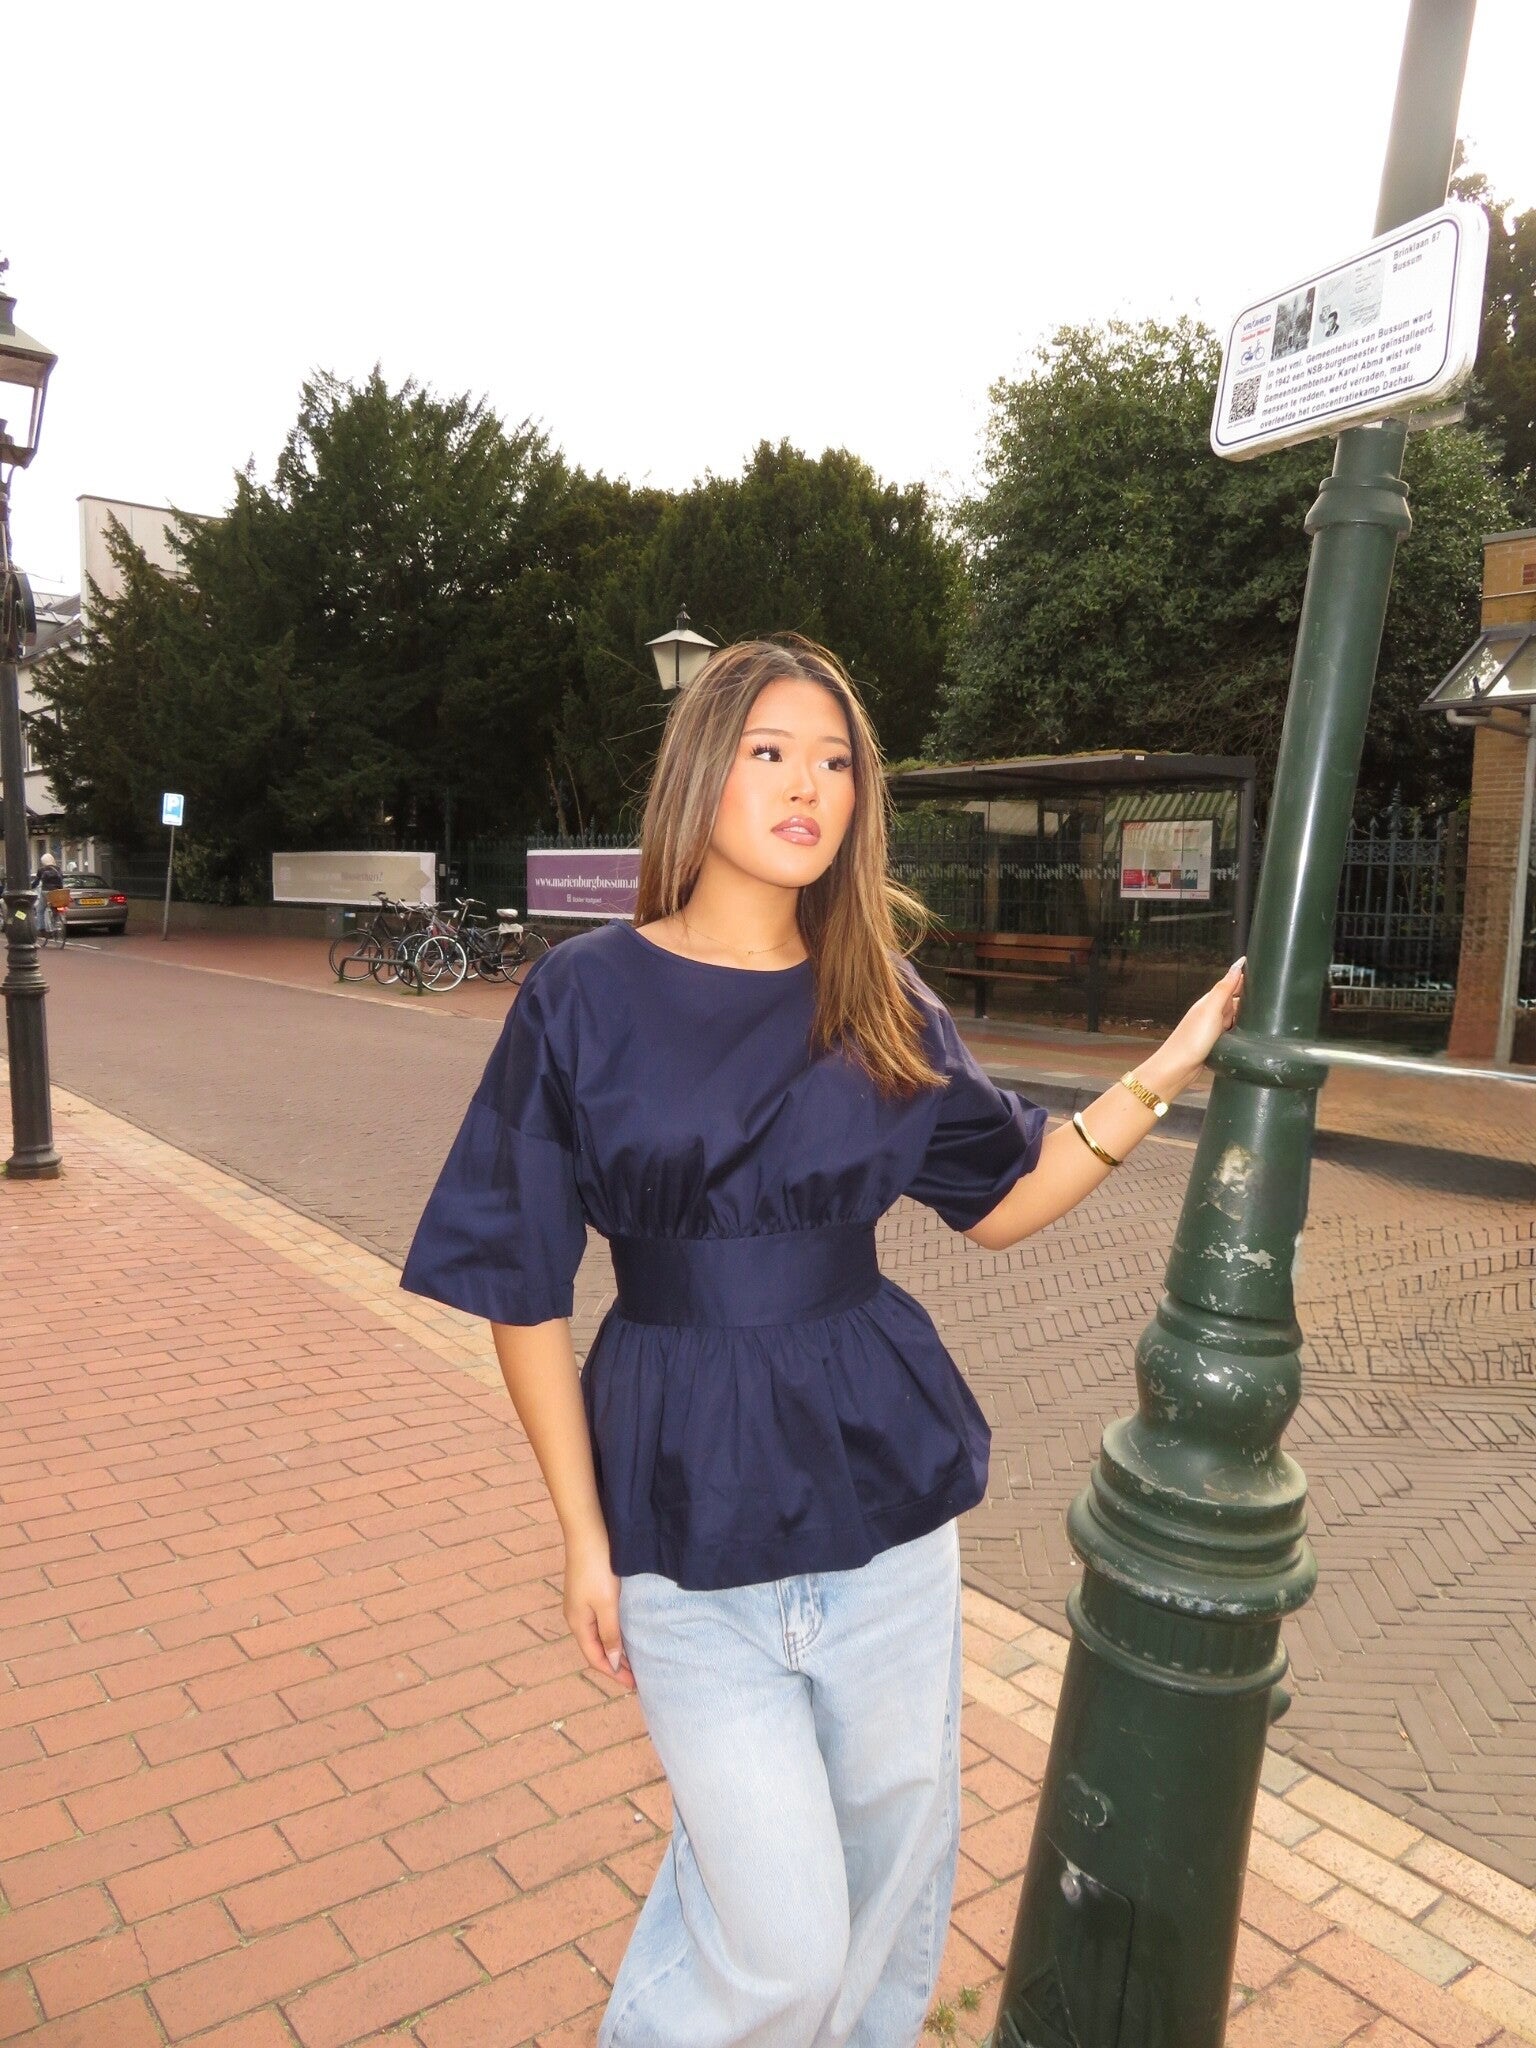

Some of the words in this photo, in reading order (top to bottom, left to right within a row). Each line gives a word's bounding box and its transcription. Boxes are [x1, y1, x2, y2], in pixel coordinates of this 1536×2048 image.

[1392, 253, 1423, 273] Bussum
[1393, 238, 1429, 260] Brinklaan
[1431, 229, 1441, 243] 87
[1276, 364, 1287, 374] het
[1306, 338, 1359, 363] Gemeentehuis
[1361, 333, 1375, 343] van
[1378, 320, 1410, 338] Bussum
[1412, 308, 1432, 324] werd
[1261, 402, 1288, 416] mensen
[1290, 398, 1297, 407] te
[1329, 380, 1348, 393] werd
[1390, 361, 1411, 374] maar
[1264, 373, 1336, 403] Gemeenteambtenaar
[1338, 364, 1359, 378] Karel
[1360, 357, 1384, 371] Abma
[1386, 350, 1402, 362] wist
[1405, 343, 1421, 355] vele
[1265, 382, 1273, 391] in
[1275, 375, 1291, 387] 1942
[1292, 371, 1305, 381] een
[1307, 345, 1378, 376] NSB-burgemeester
[1260, 411, 1296, 429] overleefde
[1298, 407, 1310, 416] het
[1311, 385, 1380, 413] concentratiekamp
